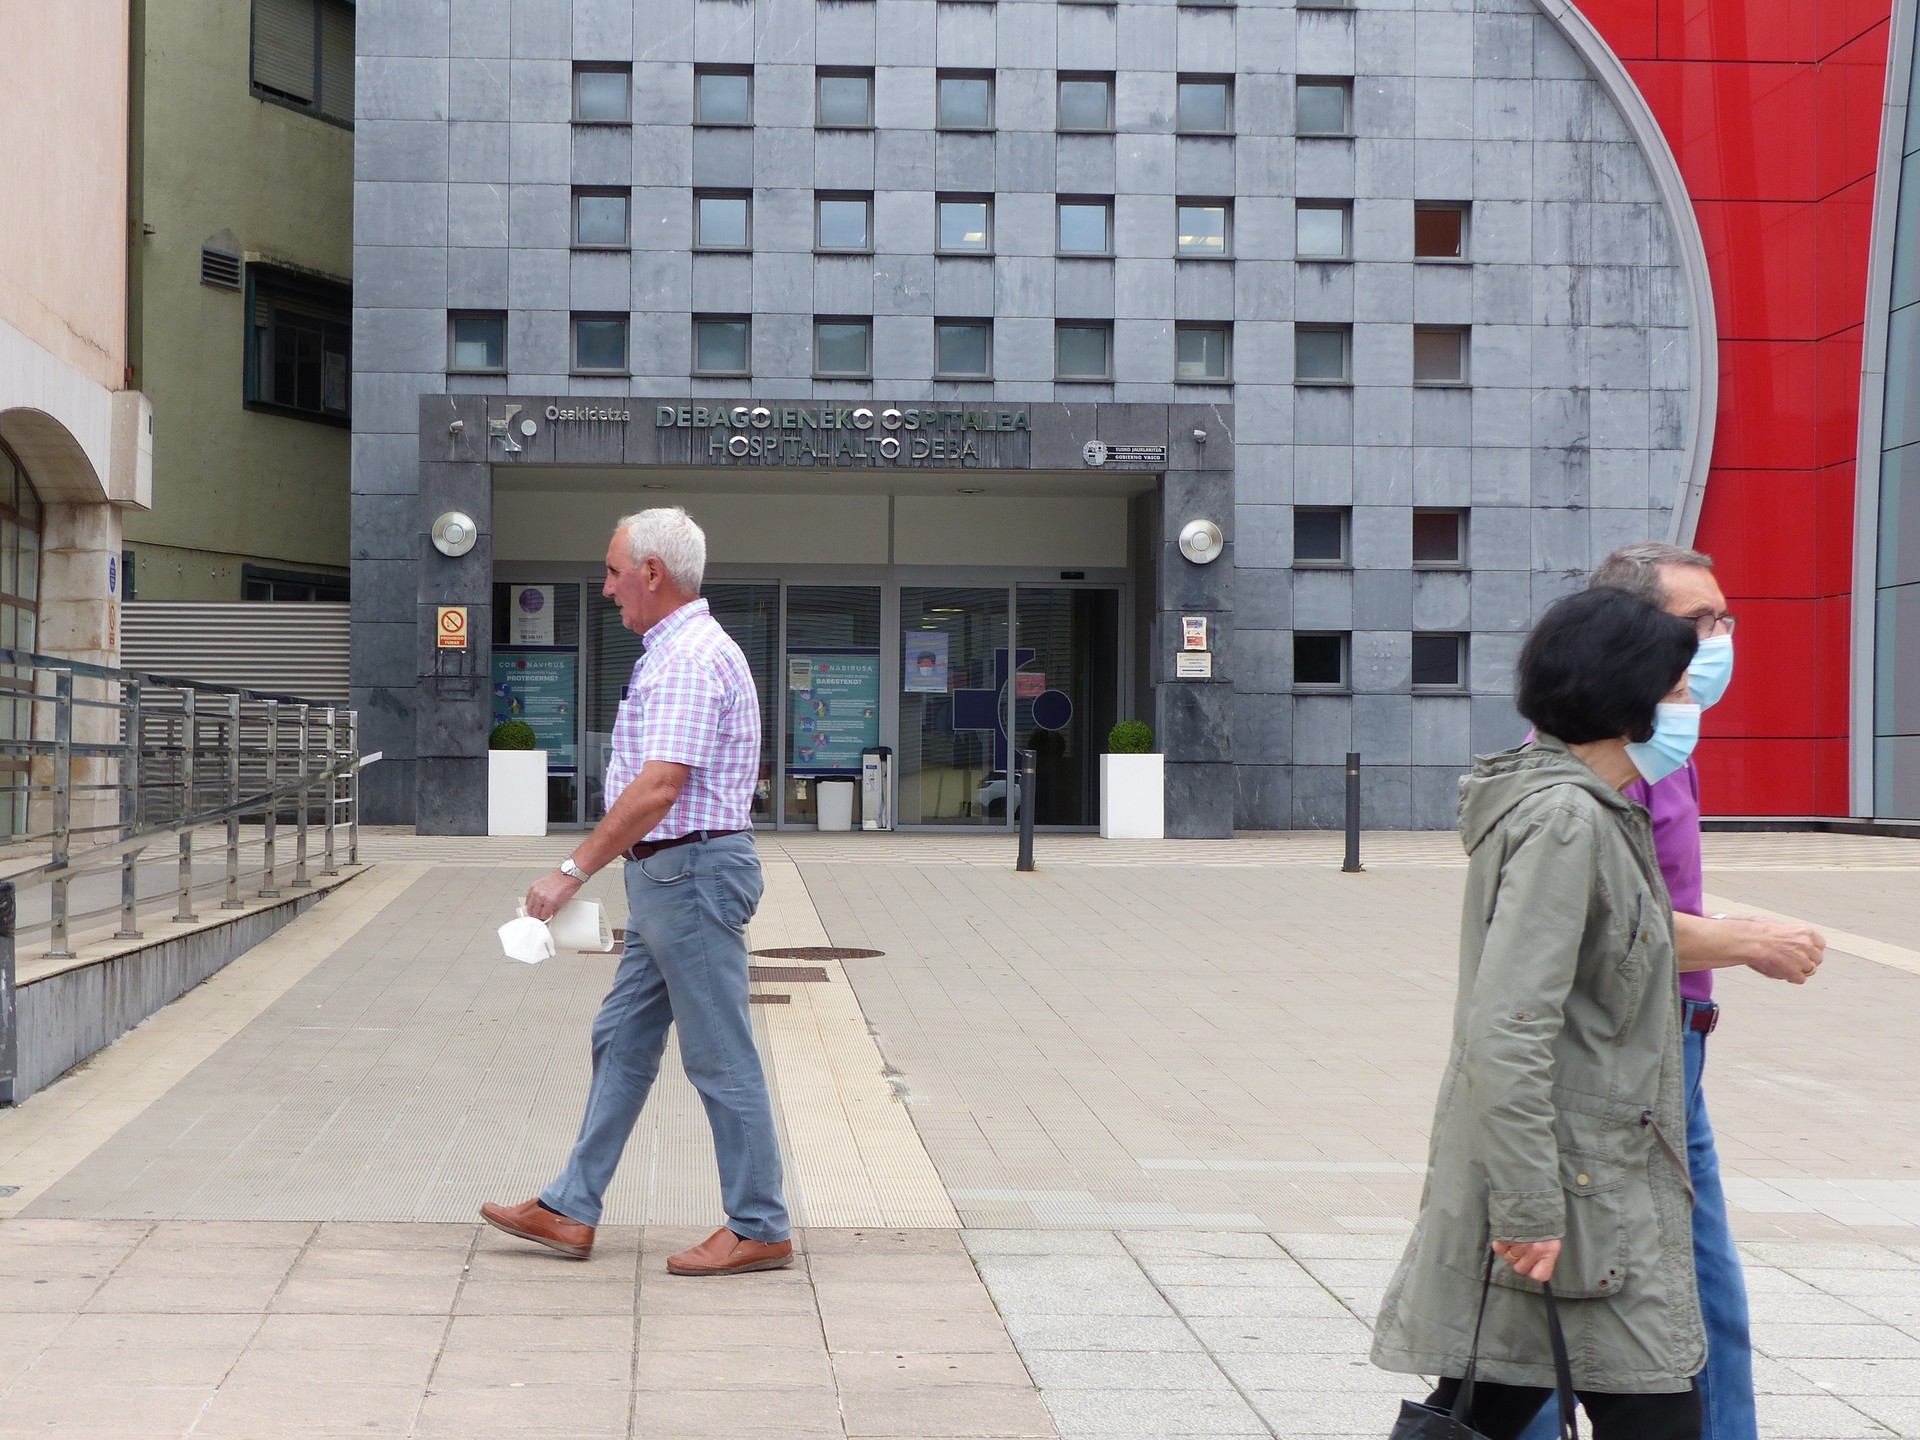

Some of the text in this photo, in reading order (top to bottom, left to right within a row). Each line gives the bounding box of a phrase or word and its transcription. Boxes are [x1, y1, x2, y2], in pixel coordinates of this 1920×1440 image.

[545, 405, 631, 422] Osakidetza
[656, 406, 1031, 432] DEBAGOIENEKO OSPITALEA
[709, 435, 979, 459] HOSPITAL ALTO DEBA
